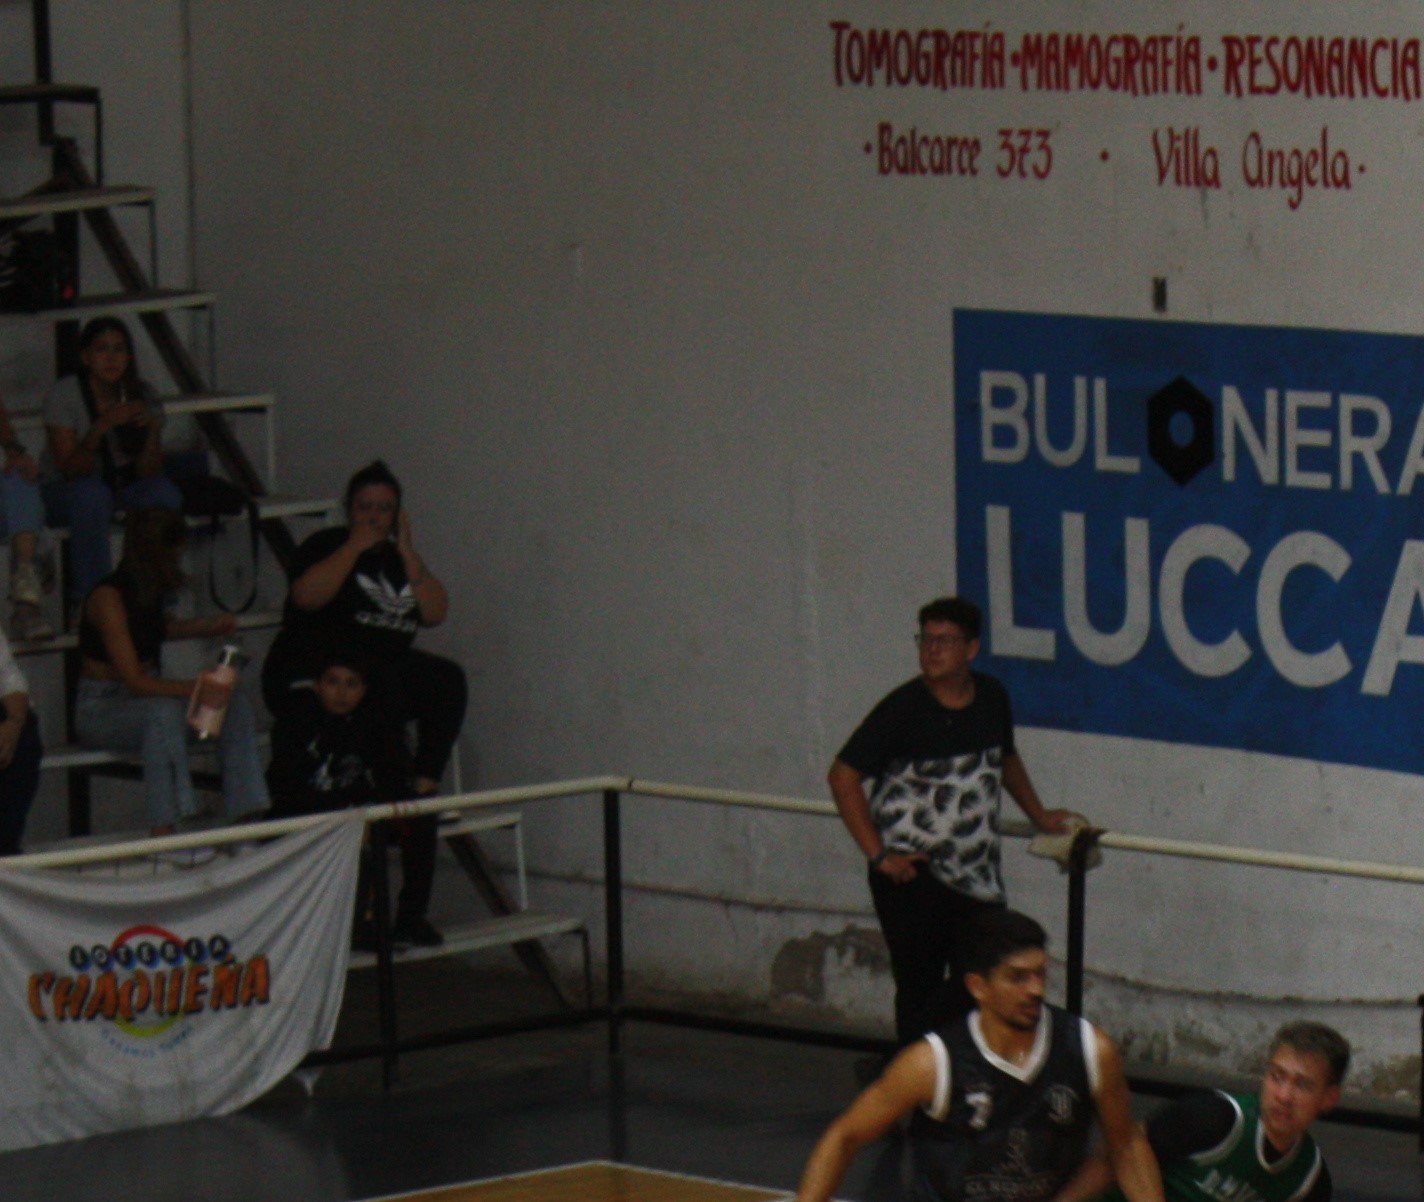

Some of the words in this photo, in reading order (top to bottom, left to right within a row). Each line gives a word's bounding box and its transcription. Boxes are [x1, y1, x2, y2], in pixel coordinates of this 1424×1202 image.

[1222, 35, 1422, 102] RESONANCIA
[996, 127, 1053, 179] 373
[1152, 126, 1221, 189] Villa
[28, 953, 270, 1022] CHAQUEÑA
